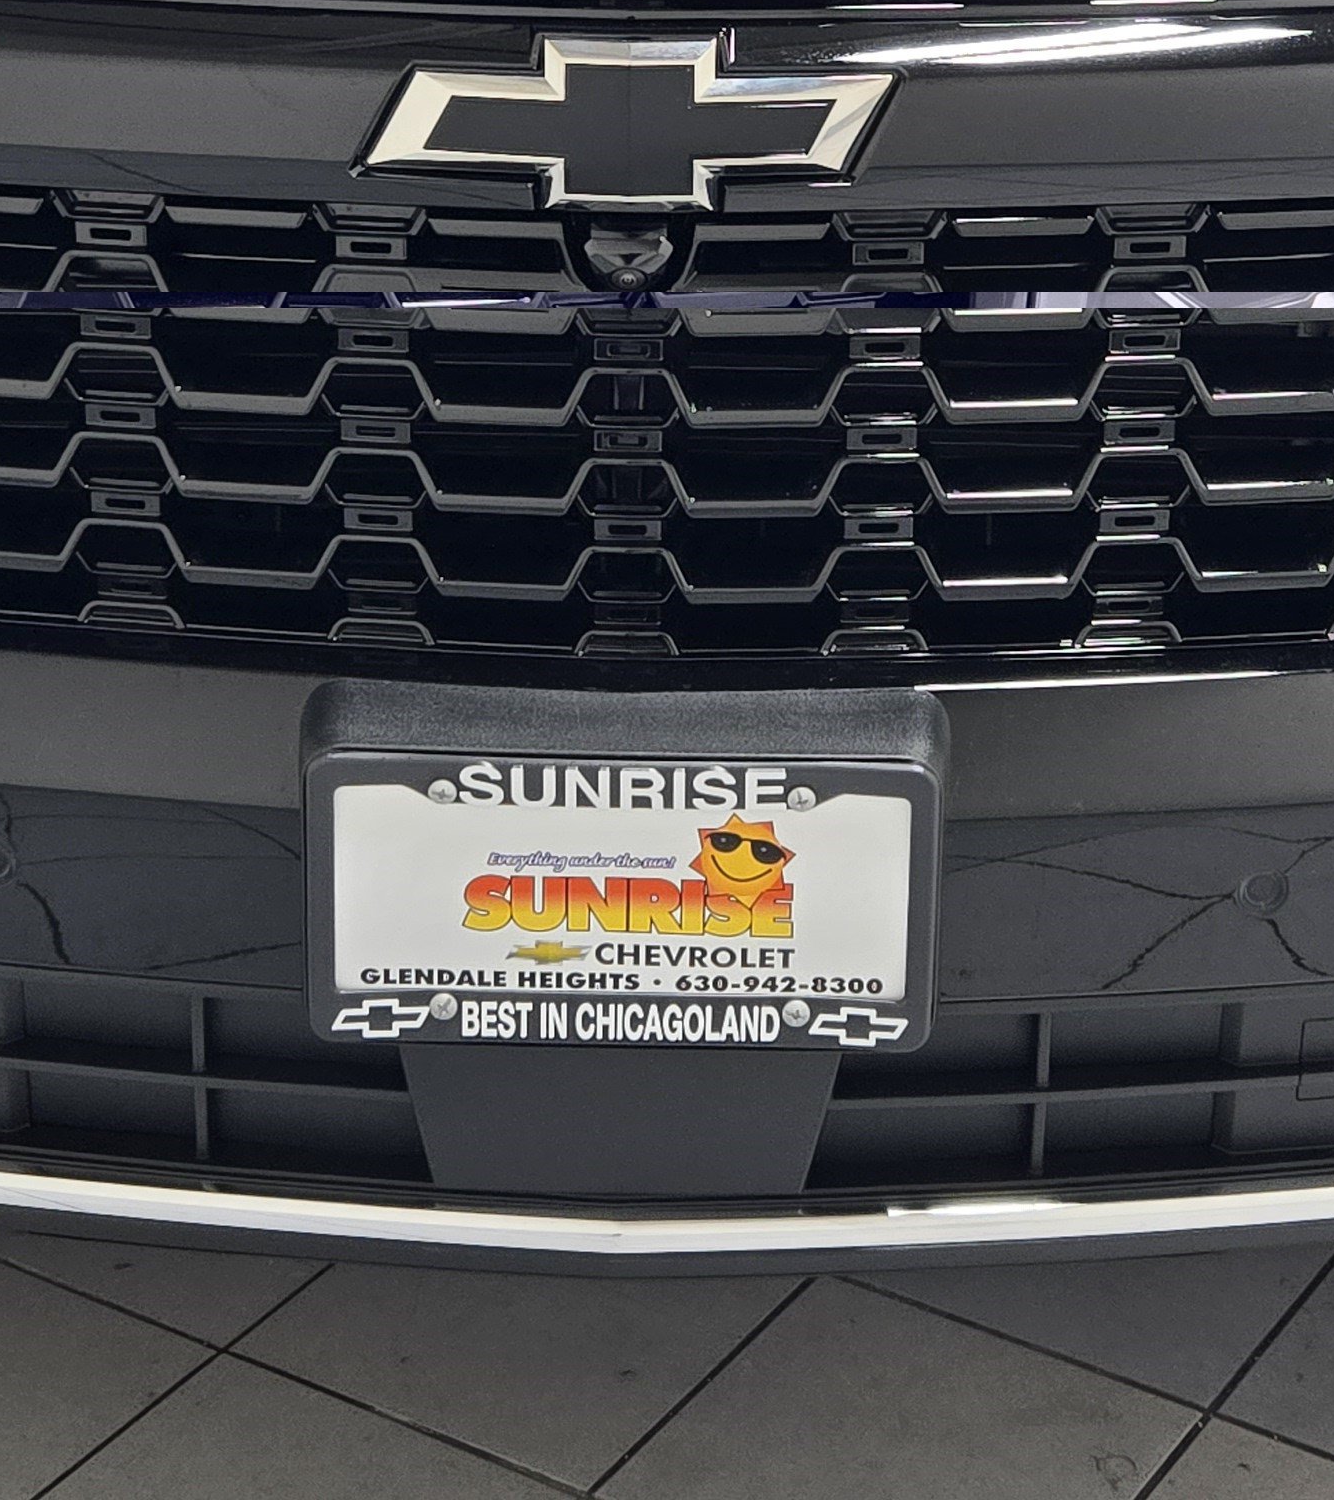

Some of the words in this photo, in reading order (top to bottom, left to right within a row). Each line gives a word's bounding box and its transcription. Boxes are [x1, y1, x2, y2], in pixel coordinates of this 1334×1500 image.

[459, 762, 787, 810] SUNRISE
[487, 850, 568, 872] Everything
[568, 851, 617, 868] under
[616, 852, 642, 868] the
[641, 855, 677, 869] sun!
[462, 874, 795, 939] SUNRISE
[595, 942, 796, 969] CHEVROLET
[360, 967, 508, 988] GLENDALE
[518, 970, 641, 990] HEIGHTS
[675, 974, 884, 994] 630-942-8300
[460, 1000, 534, 1040] BEST
[539, 1001, 568, 1041] IN
[574, 1002, 781, 1043] CHICAGOLAND
